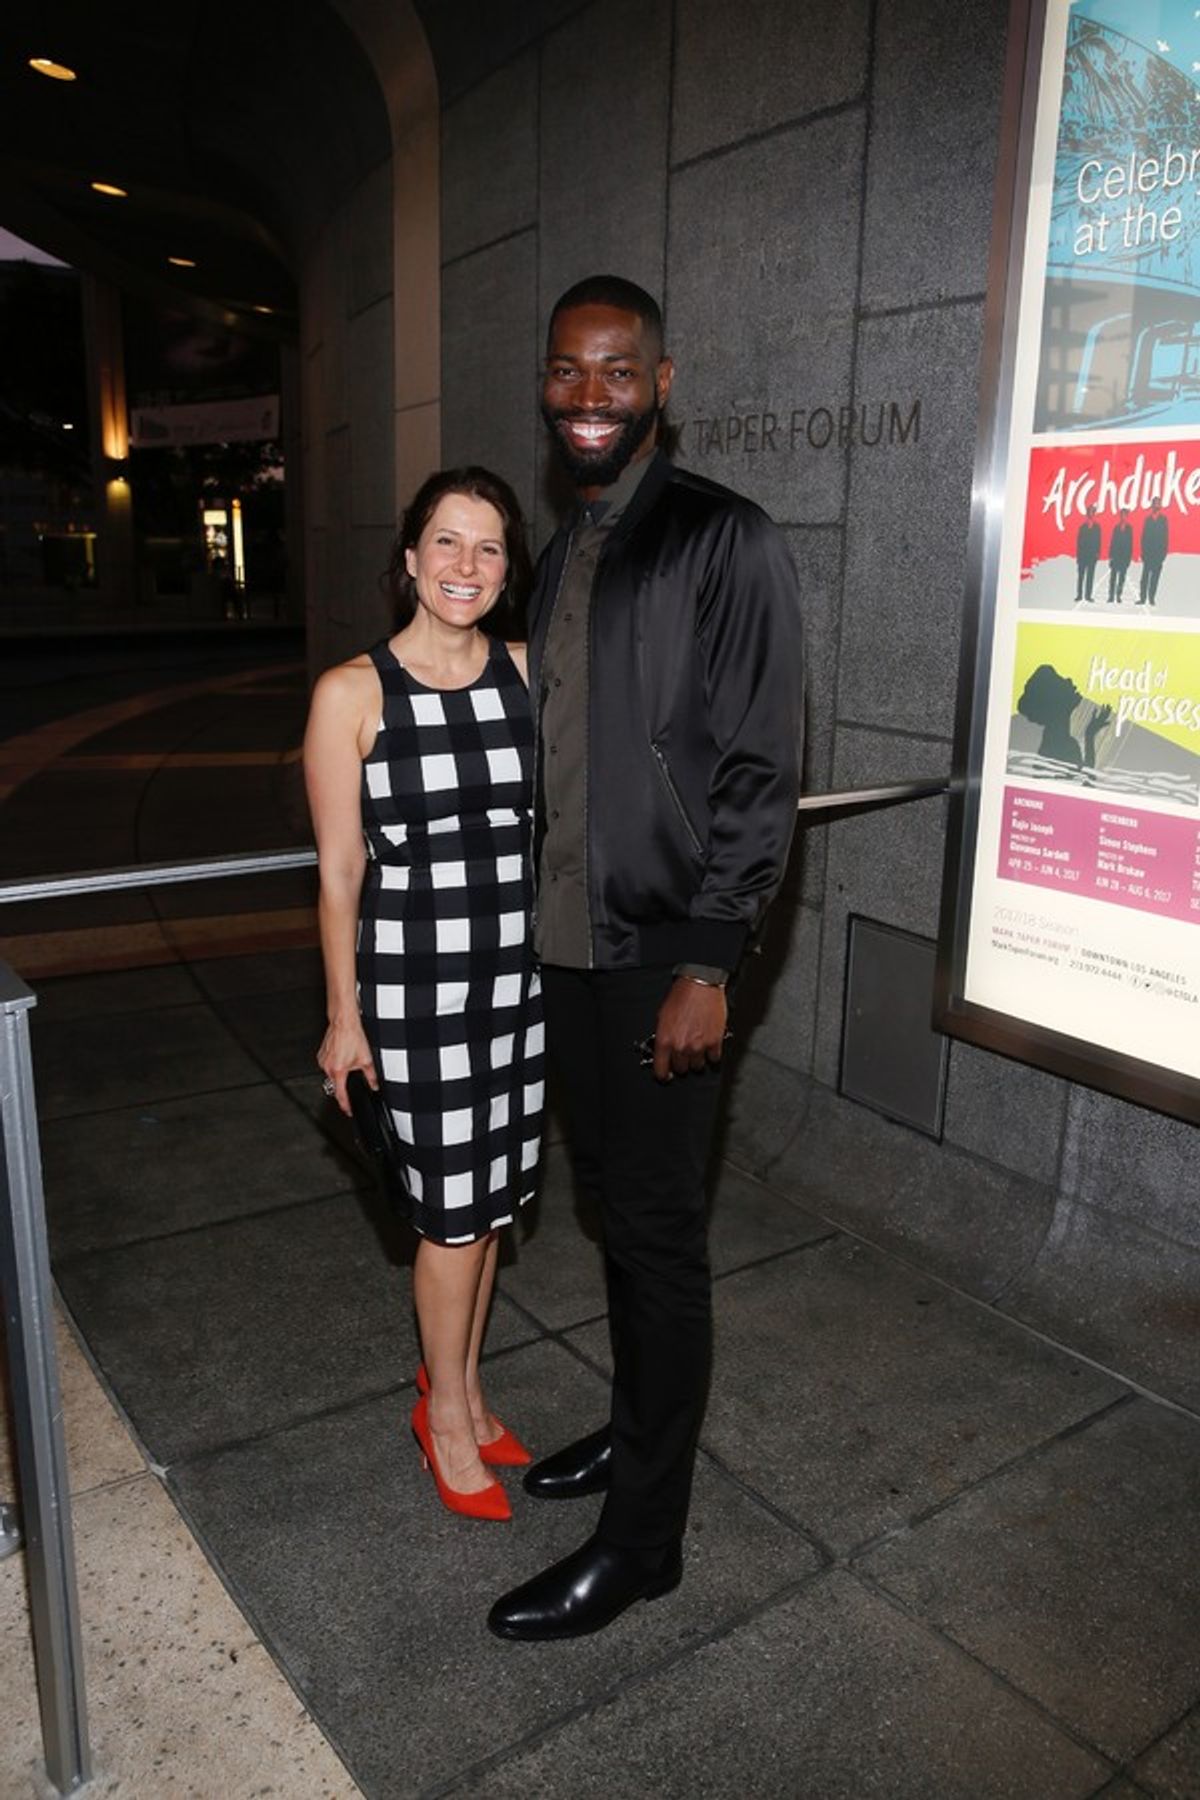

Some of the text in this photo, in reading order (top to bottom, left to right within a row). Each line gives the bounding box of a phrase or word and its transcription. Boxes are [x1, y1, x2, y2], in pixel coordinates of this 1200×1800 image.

[1078, 143, 1200, 203] Celebr
[1074, 203, 1181, 256] at the
[693, 414, 777, 455] TAPER
[790, 400, 921, 450] FORUM
[1042, 449, 1200, 532] Archduke
[1088, 655, 1169, 693] Head of
[1081, 947, 1129, 968] DOWNTOWN
[1130, 961, 1147, 975] LOS
[1149, 968, 1187, 985] ANGELES
